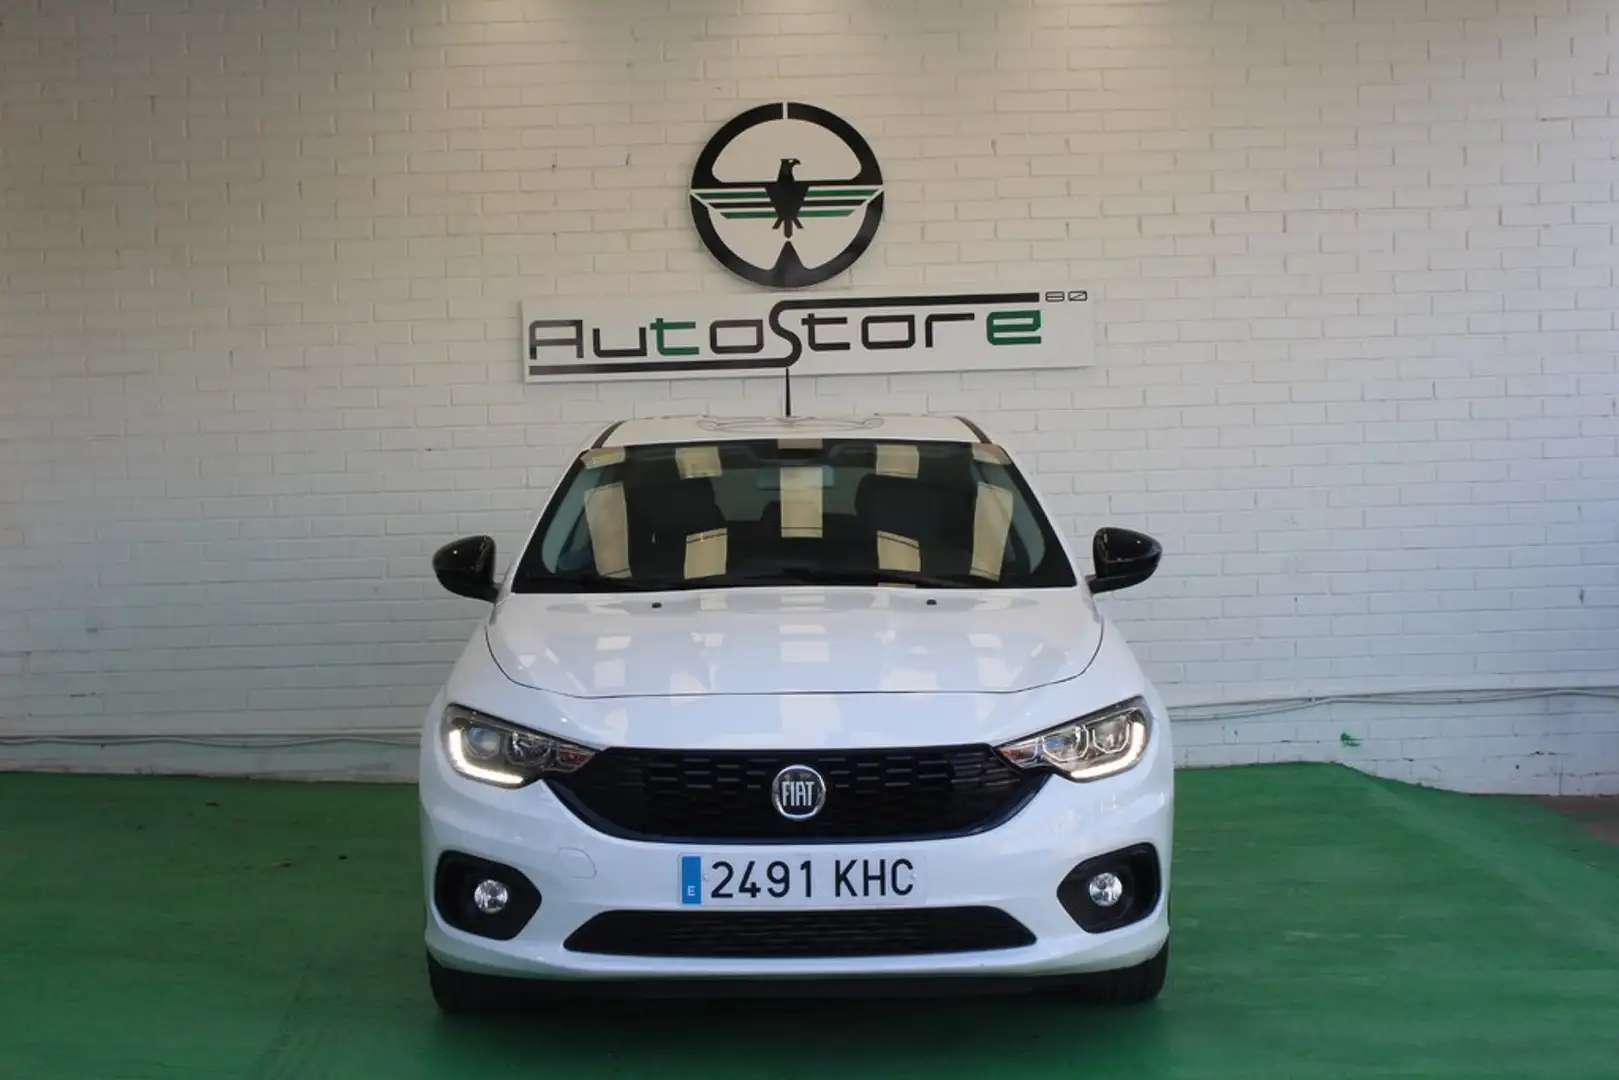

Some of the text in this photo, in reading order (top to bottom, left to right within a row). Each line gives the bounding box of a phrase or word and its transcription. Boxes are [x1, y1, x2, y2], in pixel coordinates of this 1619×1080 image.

[529, 292, 1041, 376] AutoStore
[781, 781, 815, 806] FIAT
[687, 886, 696, 896] E
[711, 858, 914, 898] 2491 KHC
